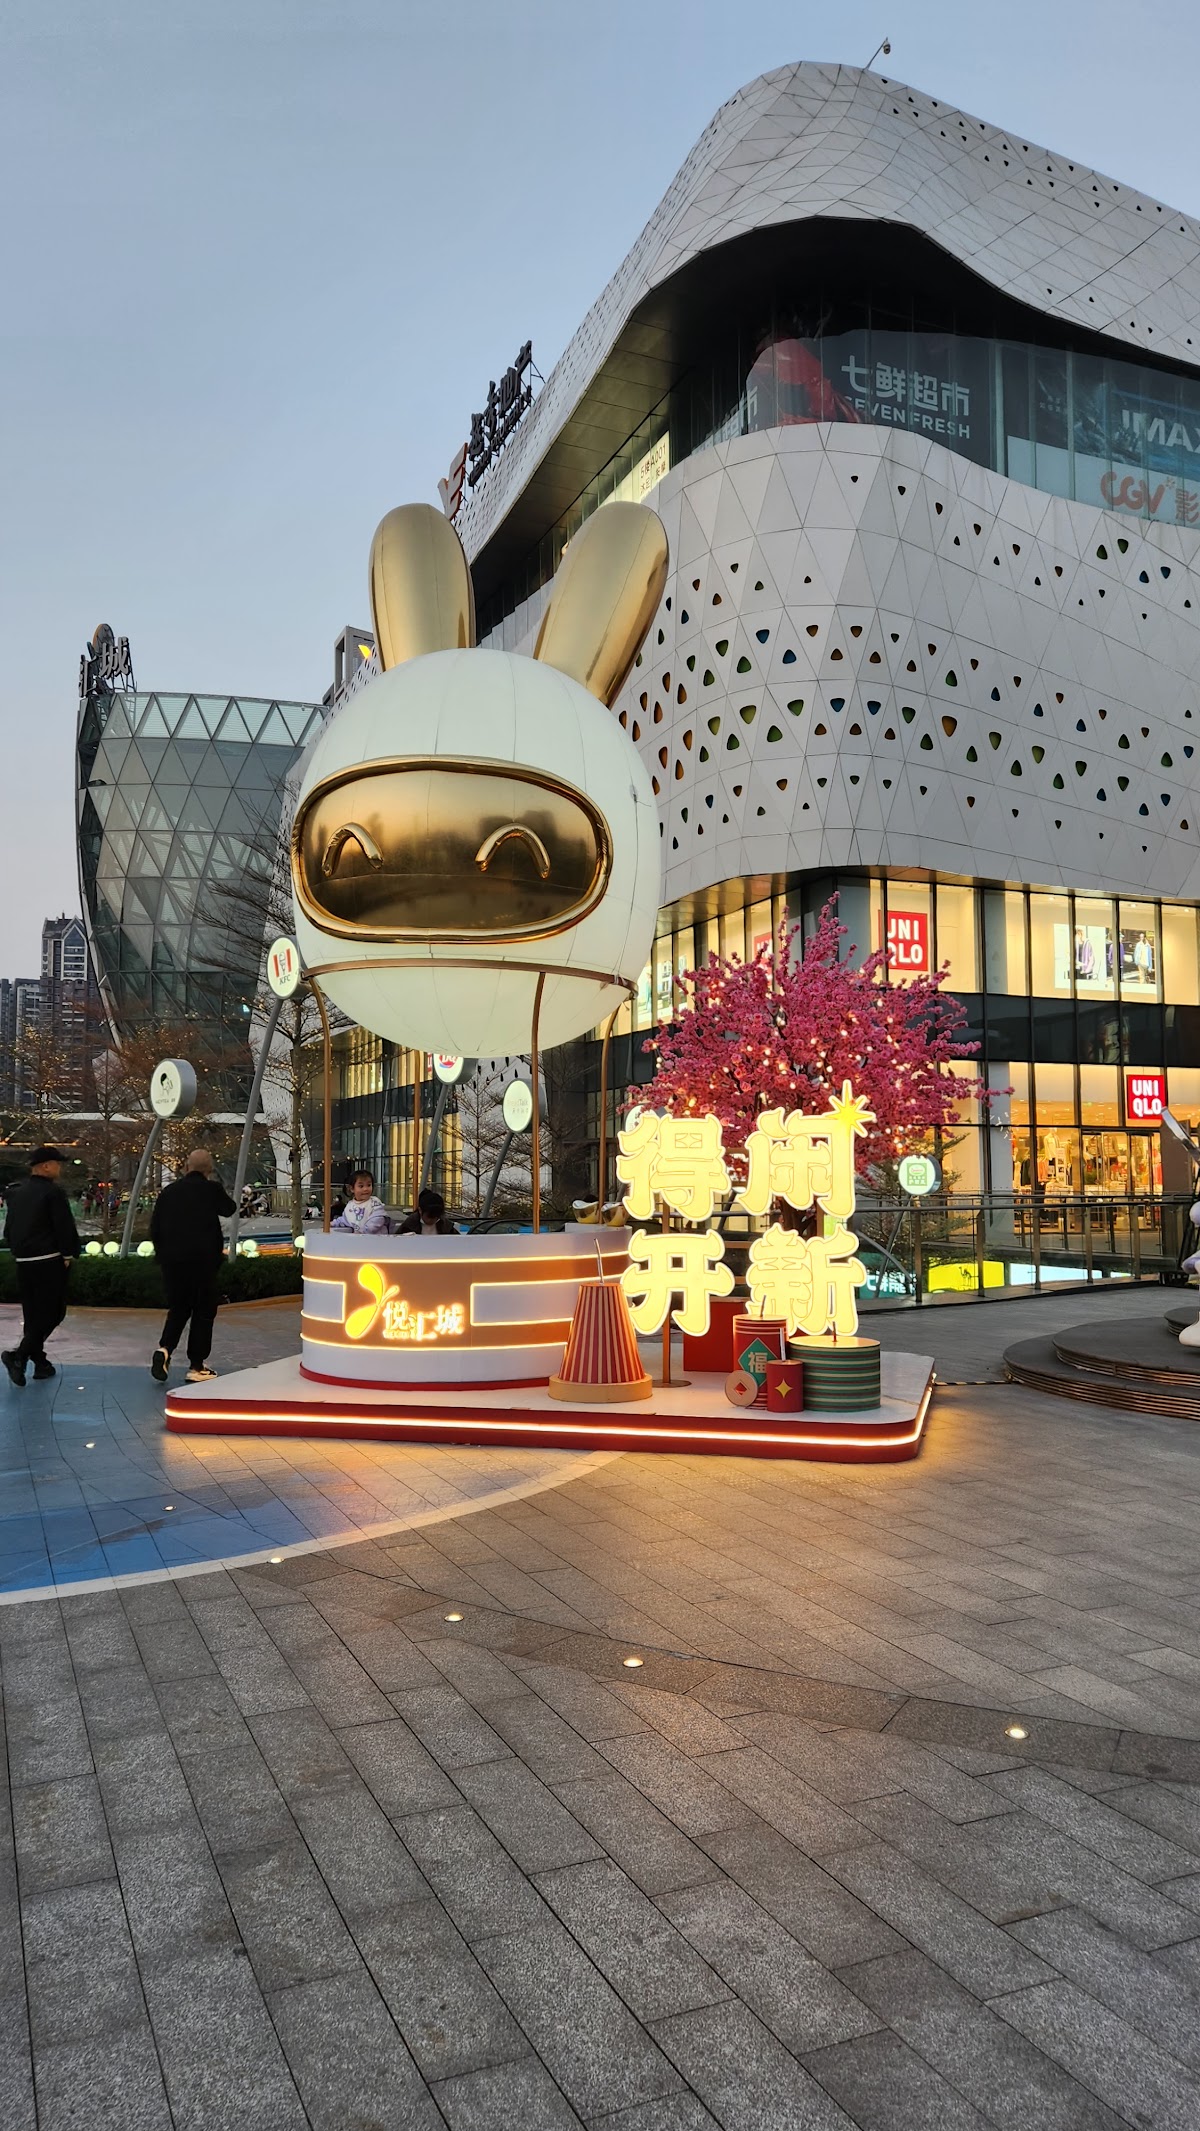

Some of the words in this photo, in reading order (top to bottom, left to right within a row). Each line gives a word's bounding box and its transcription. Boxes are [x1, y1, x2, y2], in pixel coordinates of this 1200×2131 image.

[841, 355, 970, 417] 七鲜超市
[909, 411, 970, 439] FRESH
[1122, 409, 1200, 454] IMA
[1101, 471, 1166, 514] CGV
[280, 974, 291, 985] KFC
[1132, 1079, 1159, 1097] UNI
[1132, 1097, 1162, 1118] QLO
[620, 1222, 867, 1337] 开新
[383, 1300, 464, 1341] 悦汇城
[748, 1351, 768, 1374] 福
